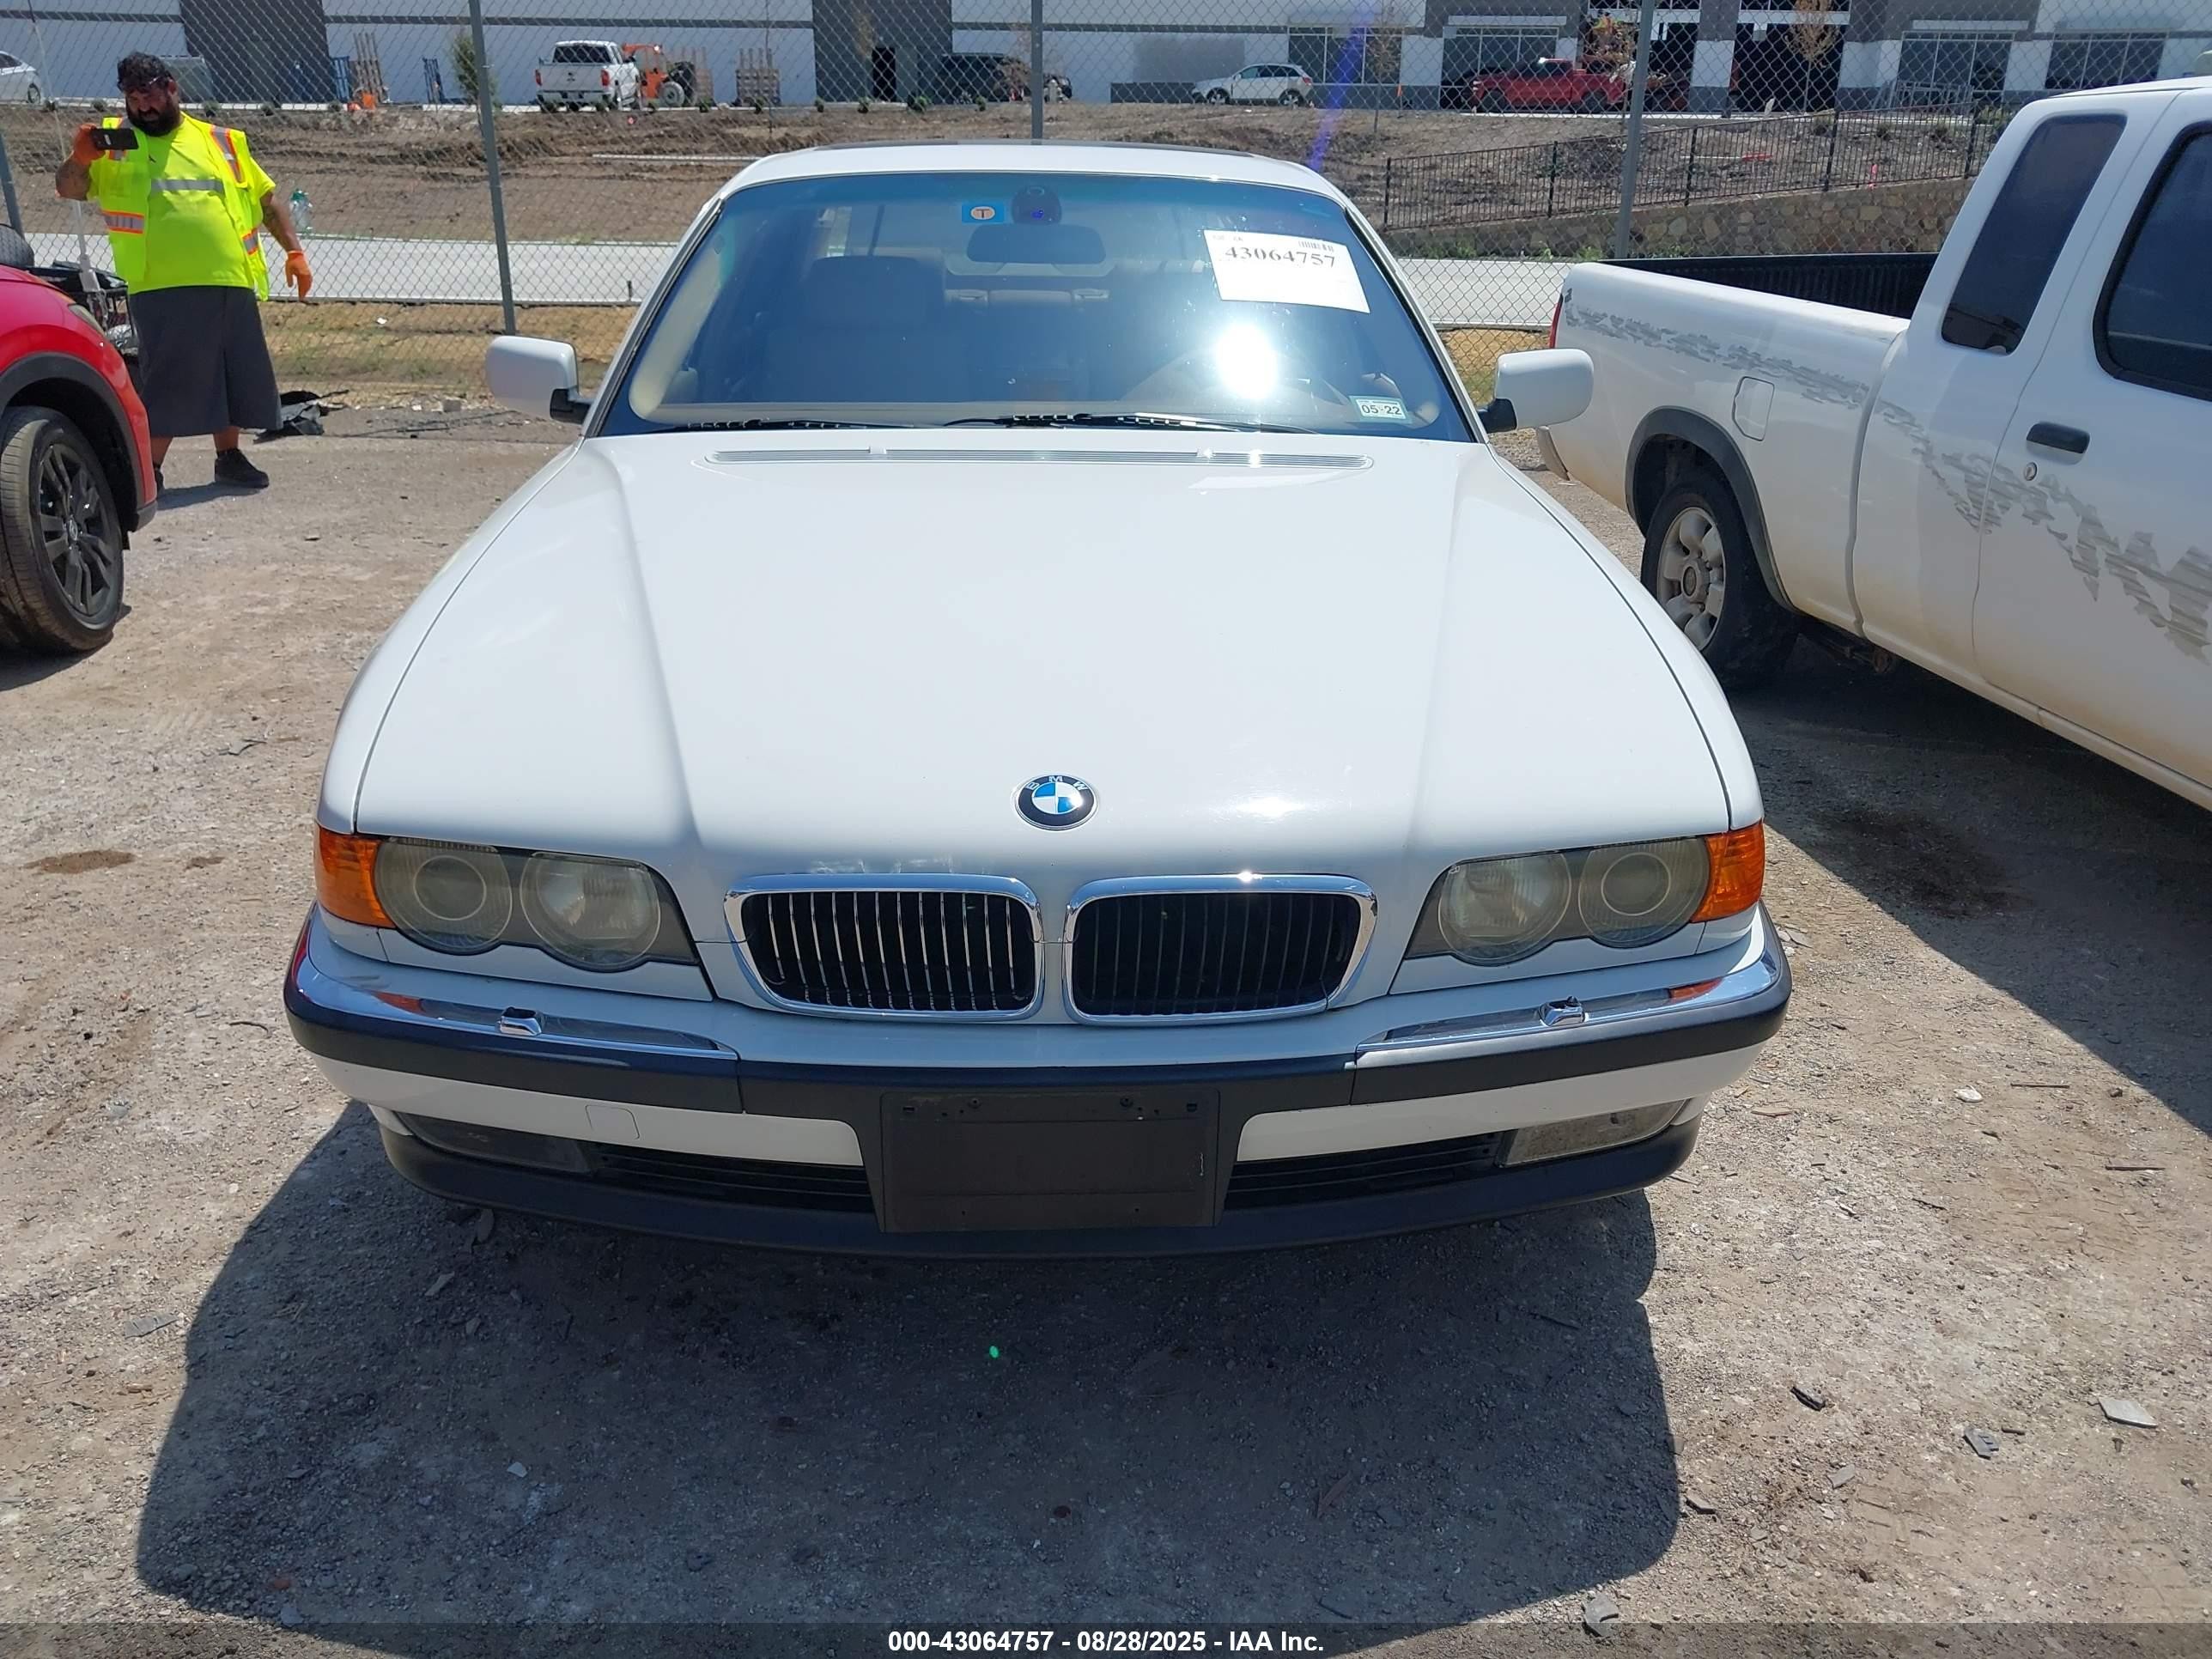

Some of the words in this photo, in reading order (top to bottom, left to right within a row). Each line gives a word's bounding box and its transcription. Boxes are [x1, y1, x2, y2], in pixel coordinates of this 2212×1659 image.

[975, 209, 990, 219] T
[1225, 246, 1335, 268] 43064757
[1362, 404, 1402, 415] 05-22
[1025, 775, 1088, 791] BMW
